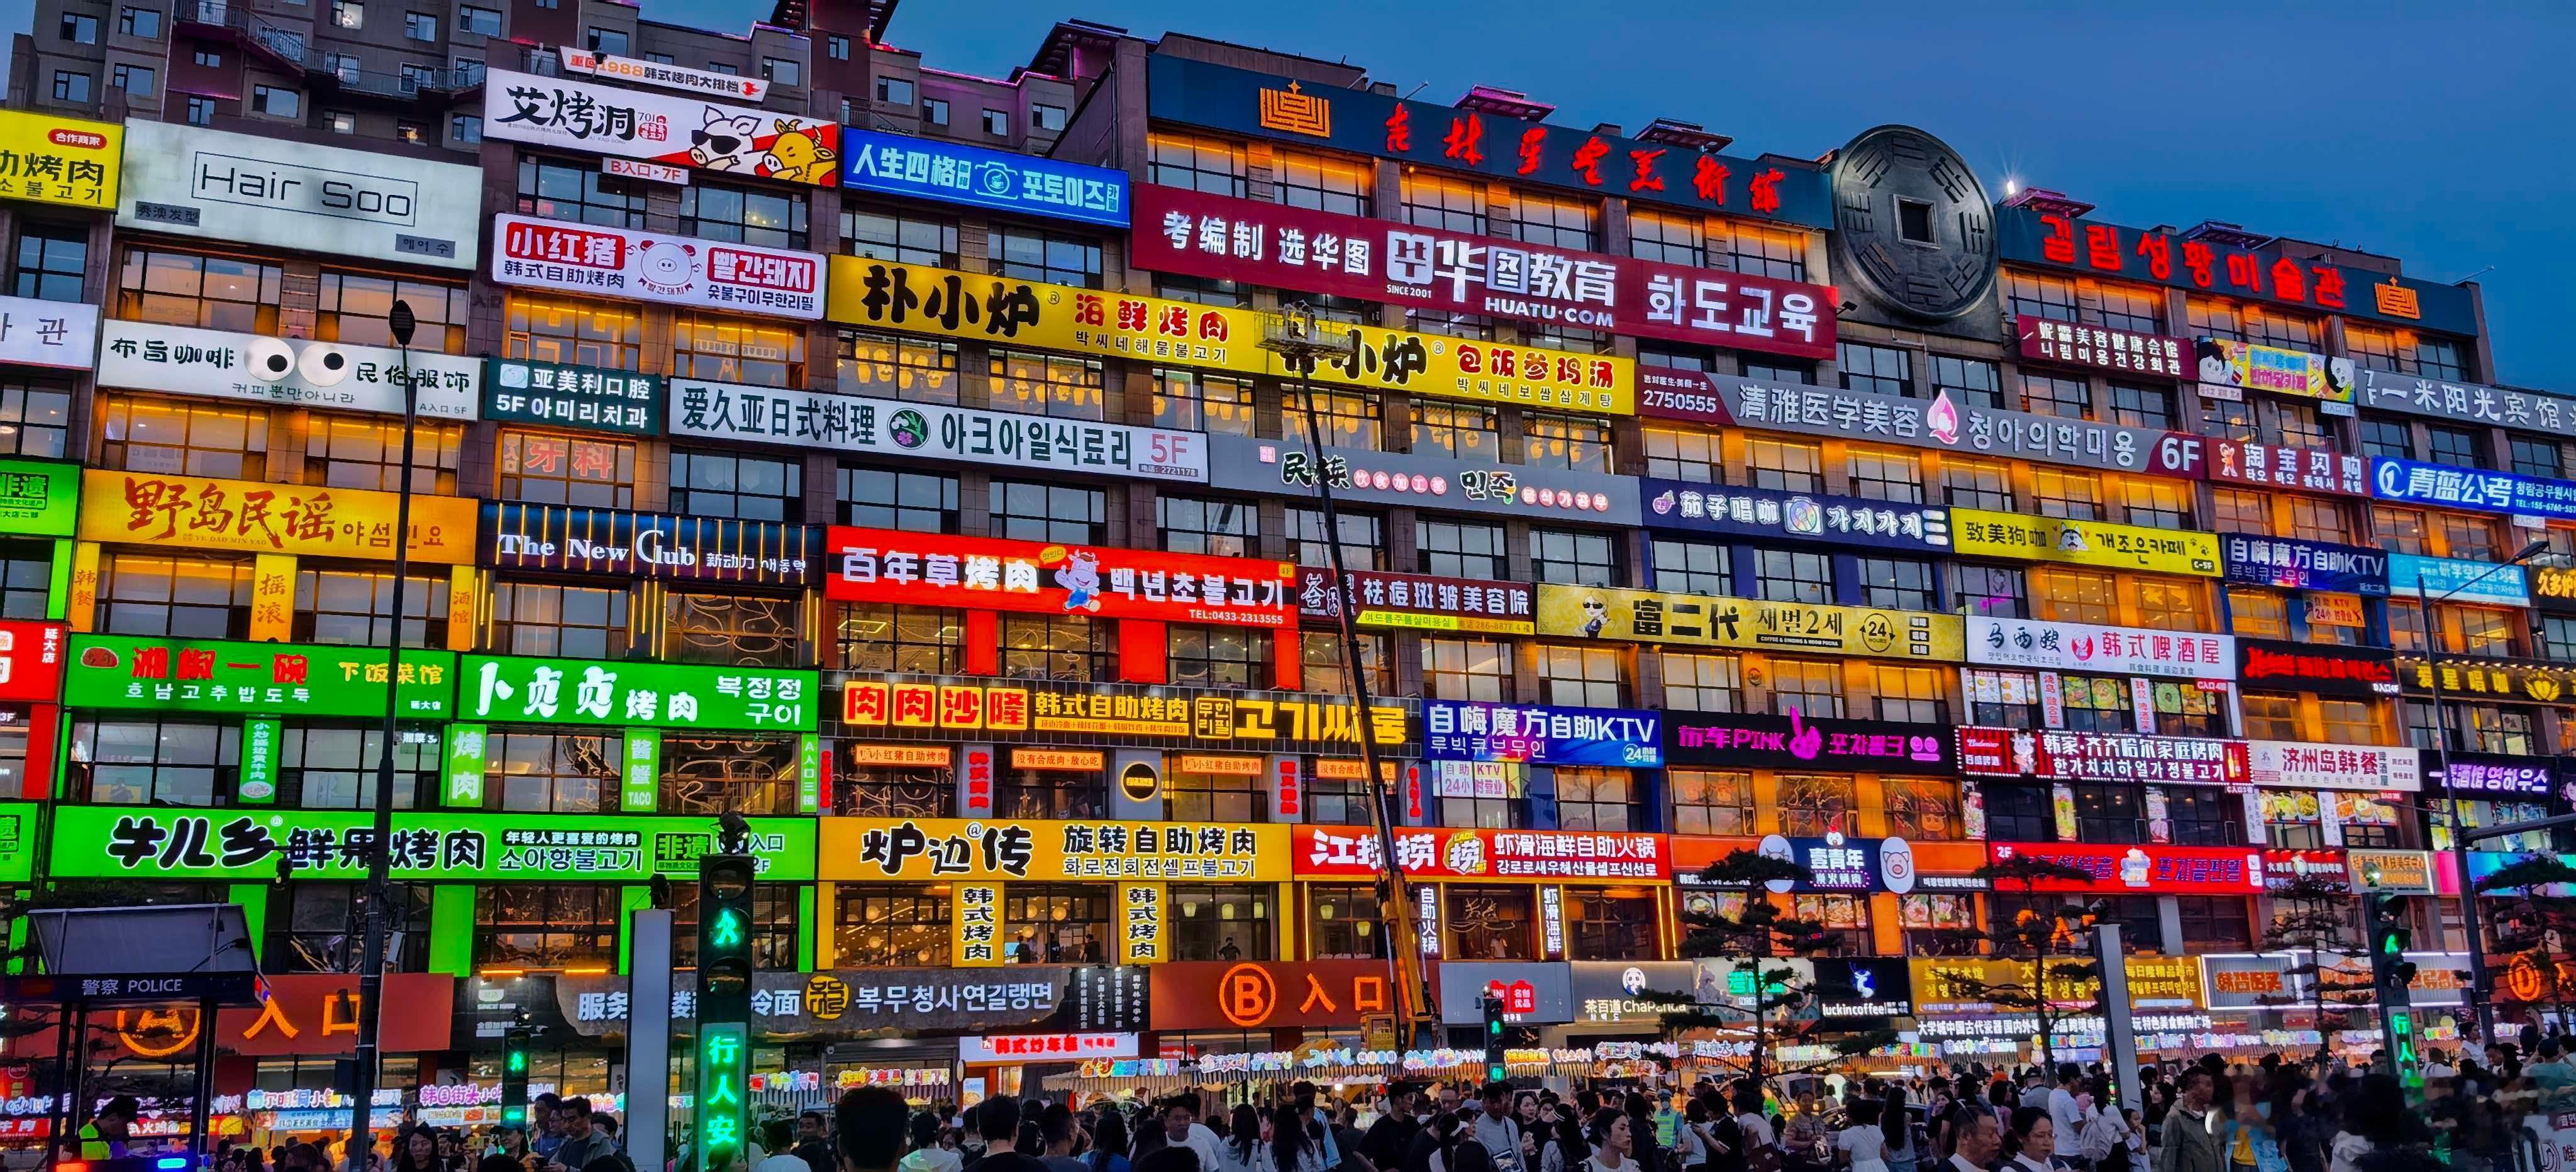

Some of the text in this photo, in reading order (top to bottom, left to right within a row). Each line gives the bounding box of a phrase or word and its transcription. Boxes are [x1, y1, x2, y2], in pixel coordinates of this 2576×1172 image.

[494, 86, 635, 141] 艾烤洞
[55, 131, 102, 146] 合作商家
[611, 160, 681, 181] B入口 7F
[853, 144, 955, 186] 人生四格
[201, 164, 410, 217] Hair Soo
[1023, 170, 1106, 210] 포토이즈
[511, 227, 618, 267] 小红猪
[1163, 211, 1370, 276] 考编制 选华图
[504, 260, 625, 289] 韩式自助烤肉
[712, 252, 813, 291] 빨간돼지
[1435, 240, 1616, 306] 华图教育
[862, 265, 1040, 337] 朴小炉
[1387, 284, 1432, 299] SINCE 2001
[1648, 275, 1817, 342] 화도교육
[1075, 293, 1228, 342] 海鲜烤肉
[1076, 331, 1227, 363] 박씨네해물불고기
[232, 382, 355, 404] 커피뿐만아니라
[357, 362, 470, 393] 民俗服饰
[534, 368, 650, 401] 亚美利口腔
[1457, 377, 1611, 408] 박씨네보쌈삼계탕
[419, 403, 467, 414] A入口 5F
[497, 394, 648, 429] 5F 아미리치과
[682, 387, 876, 446] 爱久亚日式料理
[1644, 390, 1716, 413] 2750555
[1739, 384, 1919, 438] 清雅医学美容
[2382, 379, 2560, 430] 一米阳光宾馆
[942, 413, 1131, 470] 아크아일식료리
[1150, 434, 1188, 464] 5F
[1968, 410, 2136, 467] 청아의학미용
[2161, 438, 2200, 472] 6F
[2244, 443, 2362, 477] 淘宝闪购
[2246, 468, 2267, 483] 타오
[2275, 472, 2296, 485] 바오
[2408, 467, 2513, 508] 青蓝公考
[125, 476, 335, 550] 野岛民谣
[1680, 491, 1780, 524] 茄子唱咖
[1826, 506, 1923, 539] 가지가지
[497, 529, 696, 567] The New Club
[1965, 521, 2047, 548] 致美狗咖
[706, 552, 755, 570] 新动力
[841, 546, 1038, 592] 百年草烤肉
[74, 568, 96, 607] 韩餐
[257, 573, 286, 625] 摇滚
[1111, 567, 1284, 611] 백년초불고기
[1363, 577, 1530, 616] 祛痘斑皱美容院
[1189, 609, 1284, 624] TEL:0433-2313555
[1633, 598, 1740, 640] 富二代
[1757, 607, 1843, 637] 재벌2세
[1868, 621, 1887, 638] 24
[42, 627, 58, 664] 延大店
[2102, 632, 2221, 665] 韩式啤酒屋
[131, 646, 309, 685] 湘椒一碗
[338, 661, 444, 686] 下饭菜馆
[125, 682, 311, 704] 호남고추밥도둑
[475, 661, 618, 719] 卜贞贞
[716, 675, 802, 701] 복정정
[625, 689, 699, 722] 烤肉
[744, 702, 802, 726] 구이
[847, 686, 1026, 726] 肉肉沙隆
[1035, 691, 1189, 722] 韩式自助烤肉
[1429, 704, 1655, 743] 自嗨魔方自助KTV
[1430, 736, 1546, 759] 루빅큐브무인
[2282, 747, 2379, 776] 济州岛韩餐
[452, 731, 483, 800] 烤肉
[1476, 764, 1501, 777] KTV
[628, 792, 652, 806] TACO
[287, 825, 486, 870] 鲜果烤肉
[506, 831, 638, 846] 年轻人更喜爱的烤肉
[1063, 825, 1257, 856] 旋转自助烤肉
[1494, 832, 1657, 860] 虾滑海鲜自助火锅
[1997, 846, 2012, 858] 2F
[498, 848, 642, 871] 소아향불고기
[1064, 858, 1255, 878] 화로전회전셀프불고기
[962, 888, 996, 961] 韩式烤肉
[1127, 887, 1158, 960] 韩式烤肉
[1421, 887, 1439, 954] 自助火锅
[82, 978, 182, 996] 警察 POLICE
[1235, 975, 1263, 1017] B
[1299, 972, 1383, 1014] 入口
[243, 994, 361, 1039] 入口
[1585, 999, 1621, 1014] 茶百道
